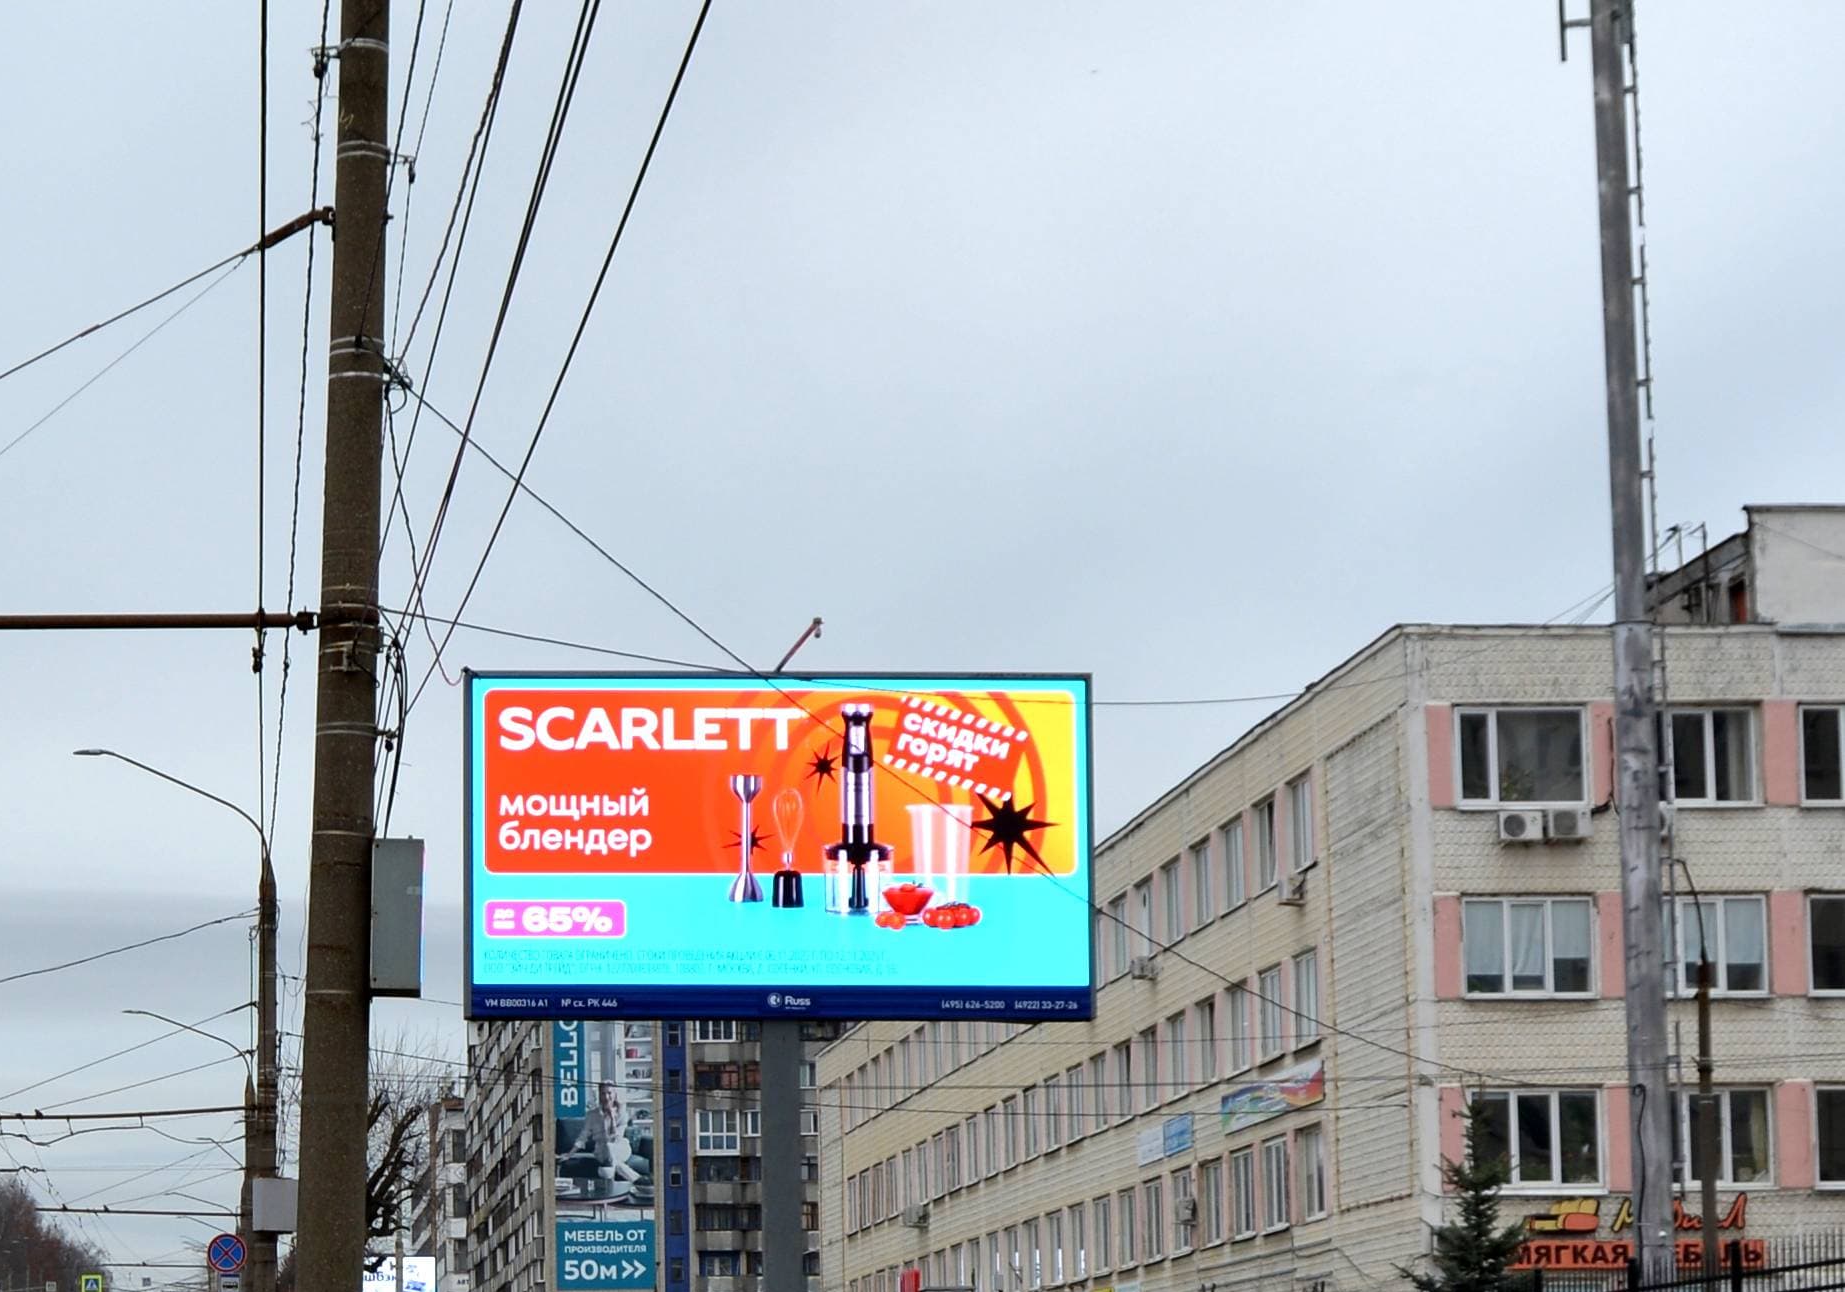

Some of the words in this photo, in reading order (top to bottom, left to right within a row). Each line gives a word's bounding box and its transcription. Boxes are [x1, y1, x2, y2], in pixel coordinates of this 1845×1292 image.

[498, 706, 807, 751] SCARLETT
[498, 787, 650, 821] мощный
[498, 821, 653, 857] блендер
[785, 995, 811, 1006] Russ
[941, 1000, 964, 1009] (495)
[965, 1000, 1005, 1009] 626-5200
[1014, 1000, 1040, 1010] (4922)
[564, 1230, 624, 1242] МЕБЕЛЬ
[626, 1229, 647, 1241] ОТ
[564, 1245, 647, 1254] ПРОИЗВОДИТЕЛЯ
